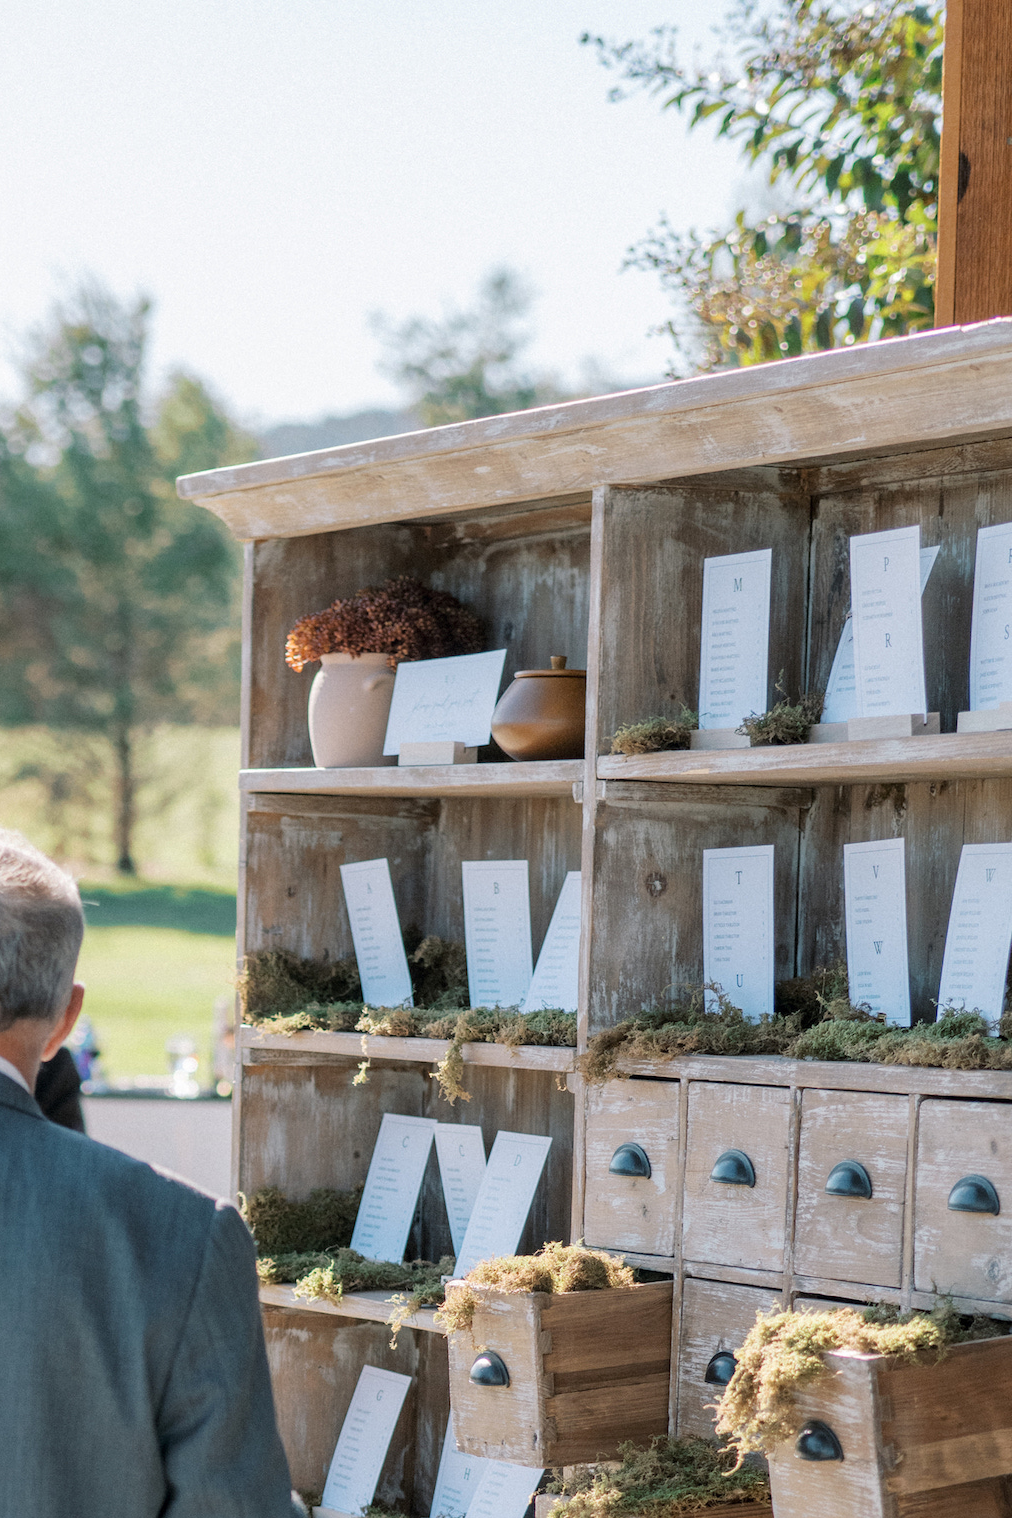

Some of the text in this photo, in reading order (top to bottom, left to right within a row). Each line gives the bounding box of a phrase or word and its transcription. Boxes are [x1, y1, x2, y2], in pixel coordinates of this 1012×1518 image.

[883, 556, 890, 572] P
[733, 577, 743, 592] M
[1003, 624, 1010, 640] S
[884, 632, 893, 648] R
[735, 870, 743, 885] T
[872, 864, 880, 879] V
[985, 868, 997, 883] W
[493, 881, 500, 895] B
[873, 941, 882, 955] W
[736, 973, 743, 988] U
[401, 1135, 410, 1149] C
[458, 1143, 466, 1158] C
[375, 1389, 385, 1402] G
[463, 1467, 472, 1481] H
